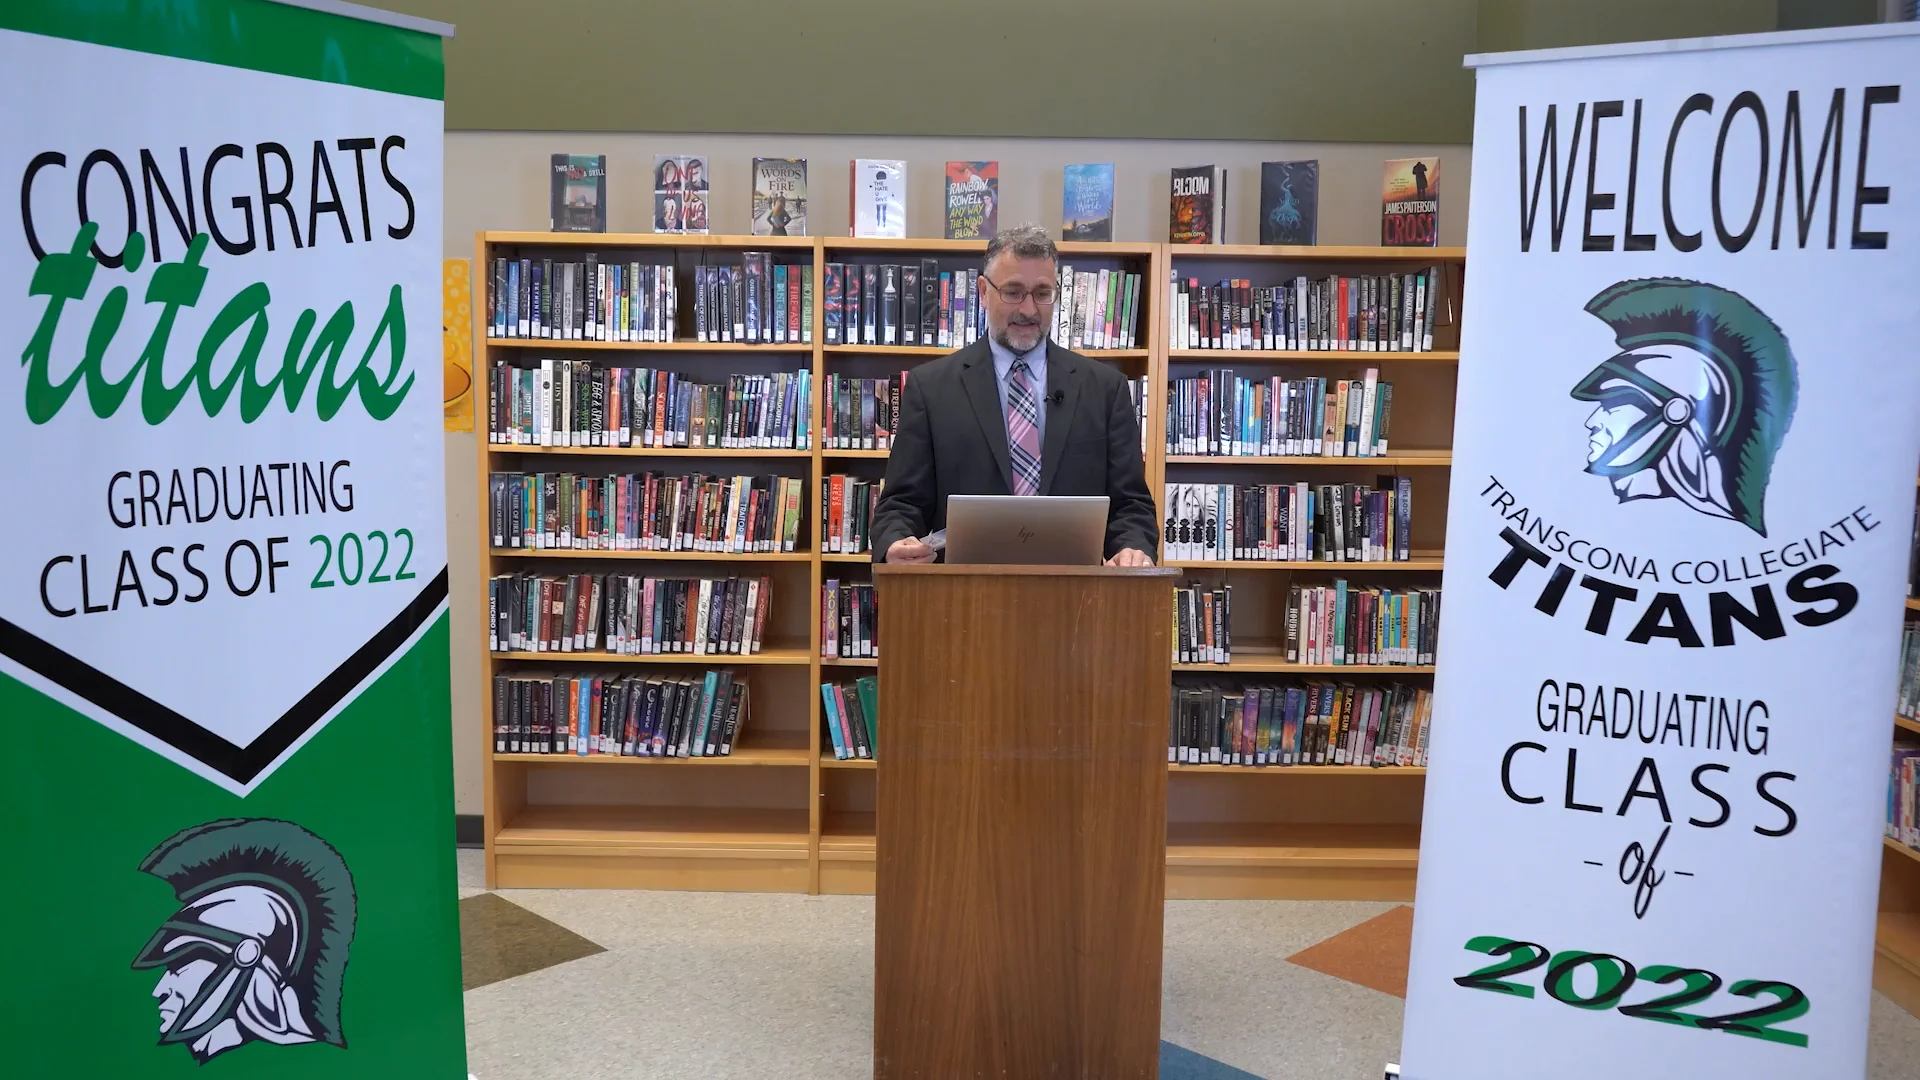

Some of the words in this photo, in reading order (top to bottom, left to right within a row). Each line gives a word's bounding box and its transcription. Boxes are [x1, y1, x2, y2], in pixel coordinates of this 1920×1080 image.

[555, 165, 568, 173] THIS
[588, 168, 605, 177] DRILL
[664, 163, 700, 185] ONE
[760, 168, 802, 180] WORDS
[1518, 85, 1901, 254] WELCOME
[683, 187, 701, 203] US
[768, 180, 796, 192] FIRE
[949, 179, 990, 196] RAINBOW
[1173, 176, 1210, 197] BLOOM
[21, 135, 416, 269] CONGRATS
[949, 192, 983, 209] ROWELL
[949, 206, 967, 219] ANY
[967, 203, 985, 216] WAY
[1384, 203, 1404, 215] JAMES
[1403, 201, 1437, 214] PATTERSON
[949, 218, 963, 230] THE
[963, 215, 984, 228] WIND
[954, 226, 980, 239] BLOWS
[1384, 213, 1435, 245] CROSS
[777, 283, 785, 303] DUST
[791, 286, 799, 305] FIRE
[804, 284, 812, 300] ROT
[804, 306, 812, 326] RUIN
[1405, 292, 1414, 321] KNOCKOUT
[21, 221, 416, 426] titans
[791, 311, 799, 329] ASH
[581, 383, 589, 400] SON
[591, 381, 603, 399] EGG
[1199, 387, 1207, 410] CROWN
[523, 393, 532, 415] IGNITE
[592, 400, 602, 408] &
[655, 391, 665, 434] SCORCHED
[775, 391, 784, 429] SHADOWFELL
[581, 409, 589, 431] WITC
[592, 409, 603, 437] SPOON
[107, 460, 354, 529] GRADUATING
[496, 510, 503, 518] OF
[512, 510, 519, 519] OF
[737, 503, 747, 532] TRAITOR
[1280, 507, 1288, 533] WANT
[1480, 475, 1660, 583] TRANSCONA
[1672, 505, 1881, 585] COLLEGIATE
[40, 544, 210, 618] CLASS
[225, 537, 290, 597] OF
[310, 528, 417, 590] 2022
[1488, 526, 1859, 648] TITANS
[579, 595, 587, 608] ONE
[828, 589, 836, 630] XOXO
[1288, 608, 1298, 641] HOUDINI
[1396, 616, 1401, 626] LU
[1309, 687, 1318, 714] RIVERS
[1323, 688, 1333, 715] RIVERS
[1344, 687, 1354, 714] BLACK
[711, 697, 724, 731] HEARTLESS
[725, 705, 738, 736] HEARTLESS
[1341, 714, 1350, 731] SUN
[1536, 679, 1770, 756] GRADUATING
[1501, 741, 1798, 837] CLASS
[1619, 825, 1671, 920] of
[1453, 935, 1810, 1048] 2022
